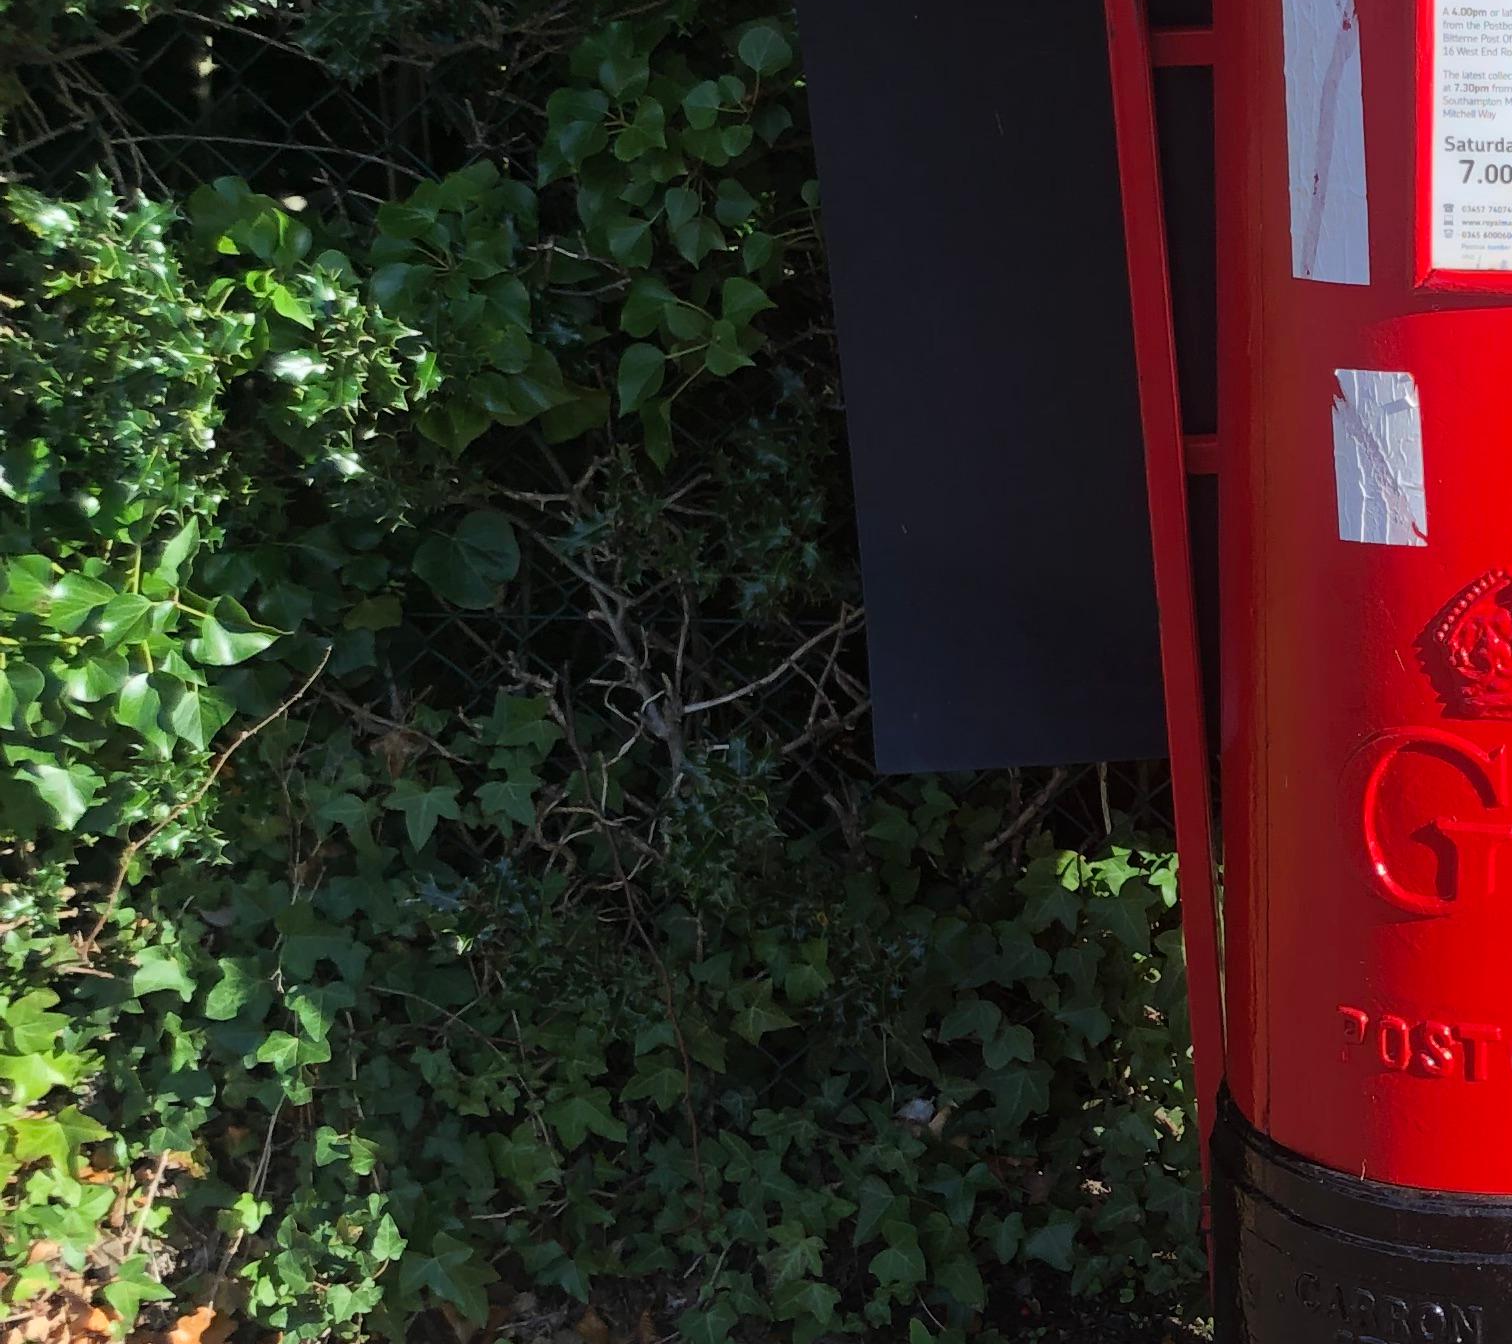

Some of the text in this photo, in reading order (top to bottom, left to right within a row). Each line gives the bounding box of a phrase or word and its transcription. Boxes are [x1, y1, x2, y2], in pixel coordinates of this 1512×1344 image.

[1442, 8, 1449, 17] A
[1451, 8, 1487, 18] 4.00pm
[1442, 21, 1464, 30] from
[1466, 21, 1480, 30] the
[1481, 34, 1499, 43] Post
[1443, 47, 1454, 56] 16
[1456, 47, 1479, 56] West
[1481, 47, 1497, 56] End
[1442, 70, 1459, 80] The
[1462, 71, 1486, 80] latest
[1442, 83, 1512, 94] at 7.30pm from
[1442, 96, 1502, 107] Southampton
[1478, 110, 1496, 121] Way
[1335, 1004, 1502, 1083] POST
